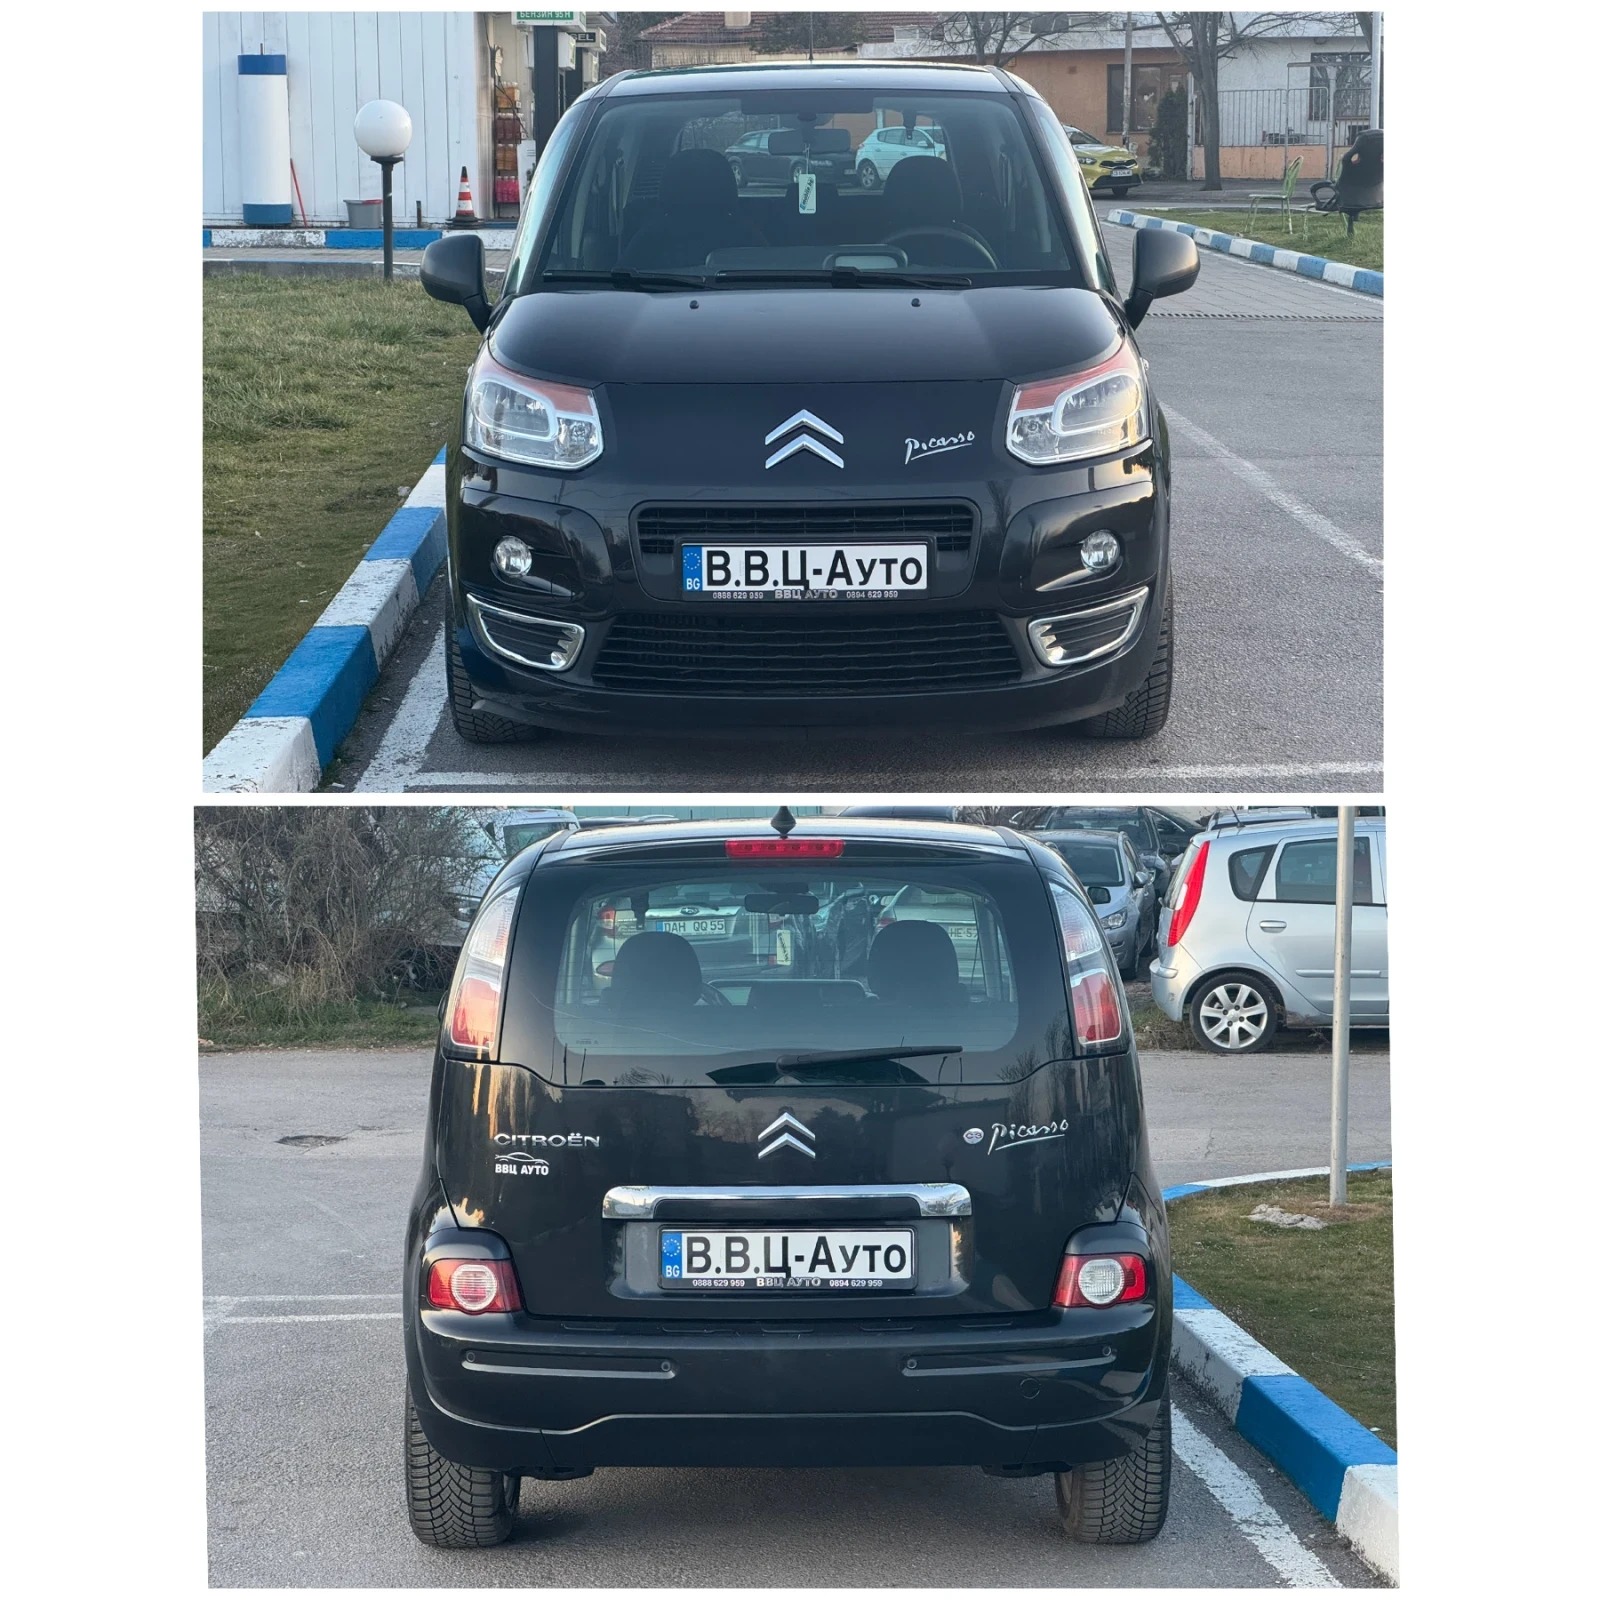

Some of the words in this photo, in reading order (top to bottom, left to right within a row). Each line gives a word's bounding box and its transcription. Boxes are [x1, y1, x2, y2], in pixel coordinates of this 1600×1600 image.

[706, 549, 923, 590] В.В.Ц-Ауто
[686, 578, 700, 590] BG
[712, 591, 732, 599] 0888
[732, 591, 748, 599] 629
[749, 591, 764, 599] 959
[774, 589, 802, 600] ВВЦ
[804, 589, 838, 599] АУТО
[846, 590, 866, 599] 0894
[867, 590, 882, 599] 629
[883, 590, 899, 599] 959
[693, 921, 708, 932] QQ
[710, 920, 724, 931] 55
[493, 1132, 600, 1148] CITROËN
[495, 1164, 517, 1175] ВВЦ
[520, 1164, 550, 1176] АУТО
[686, 1236, 906, 1278] В.В.Ц-Ауто
[665, 1265, 680, 1278] BG
[692, 1279, 712, 1287] 0888
[713, 1279, 729, 1287] 629
[730, 1279, 745, 1287] 959
[756, 1277, 784, 1288] ВВЦ
[786, 1277, 821, 1287] АУТО
[829, 1279, 849, 1287] 0894
[850, 1279, 866, 1287] 629
[867, 1279, 883, 1287] 959
